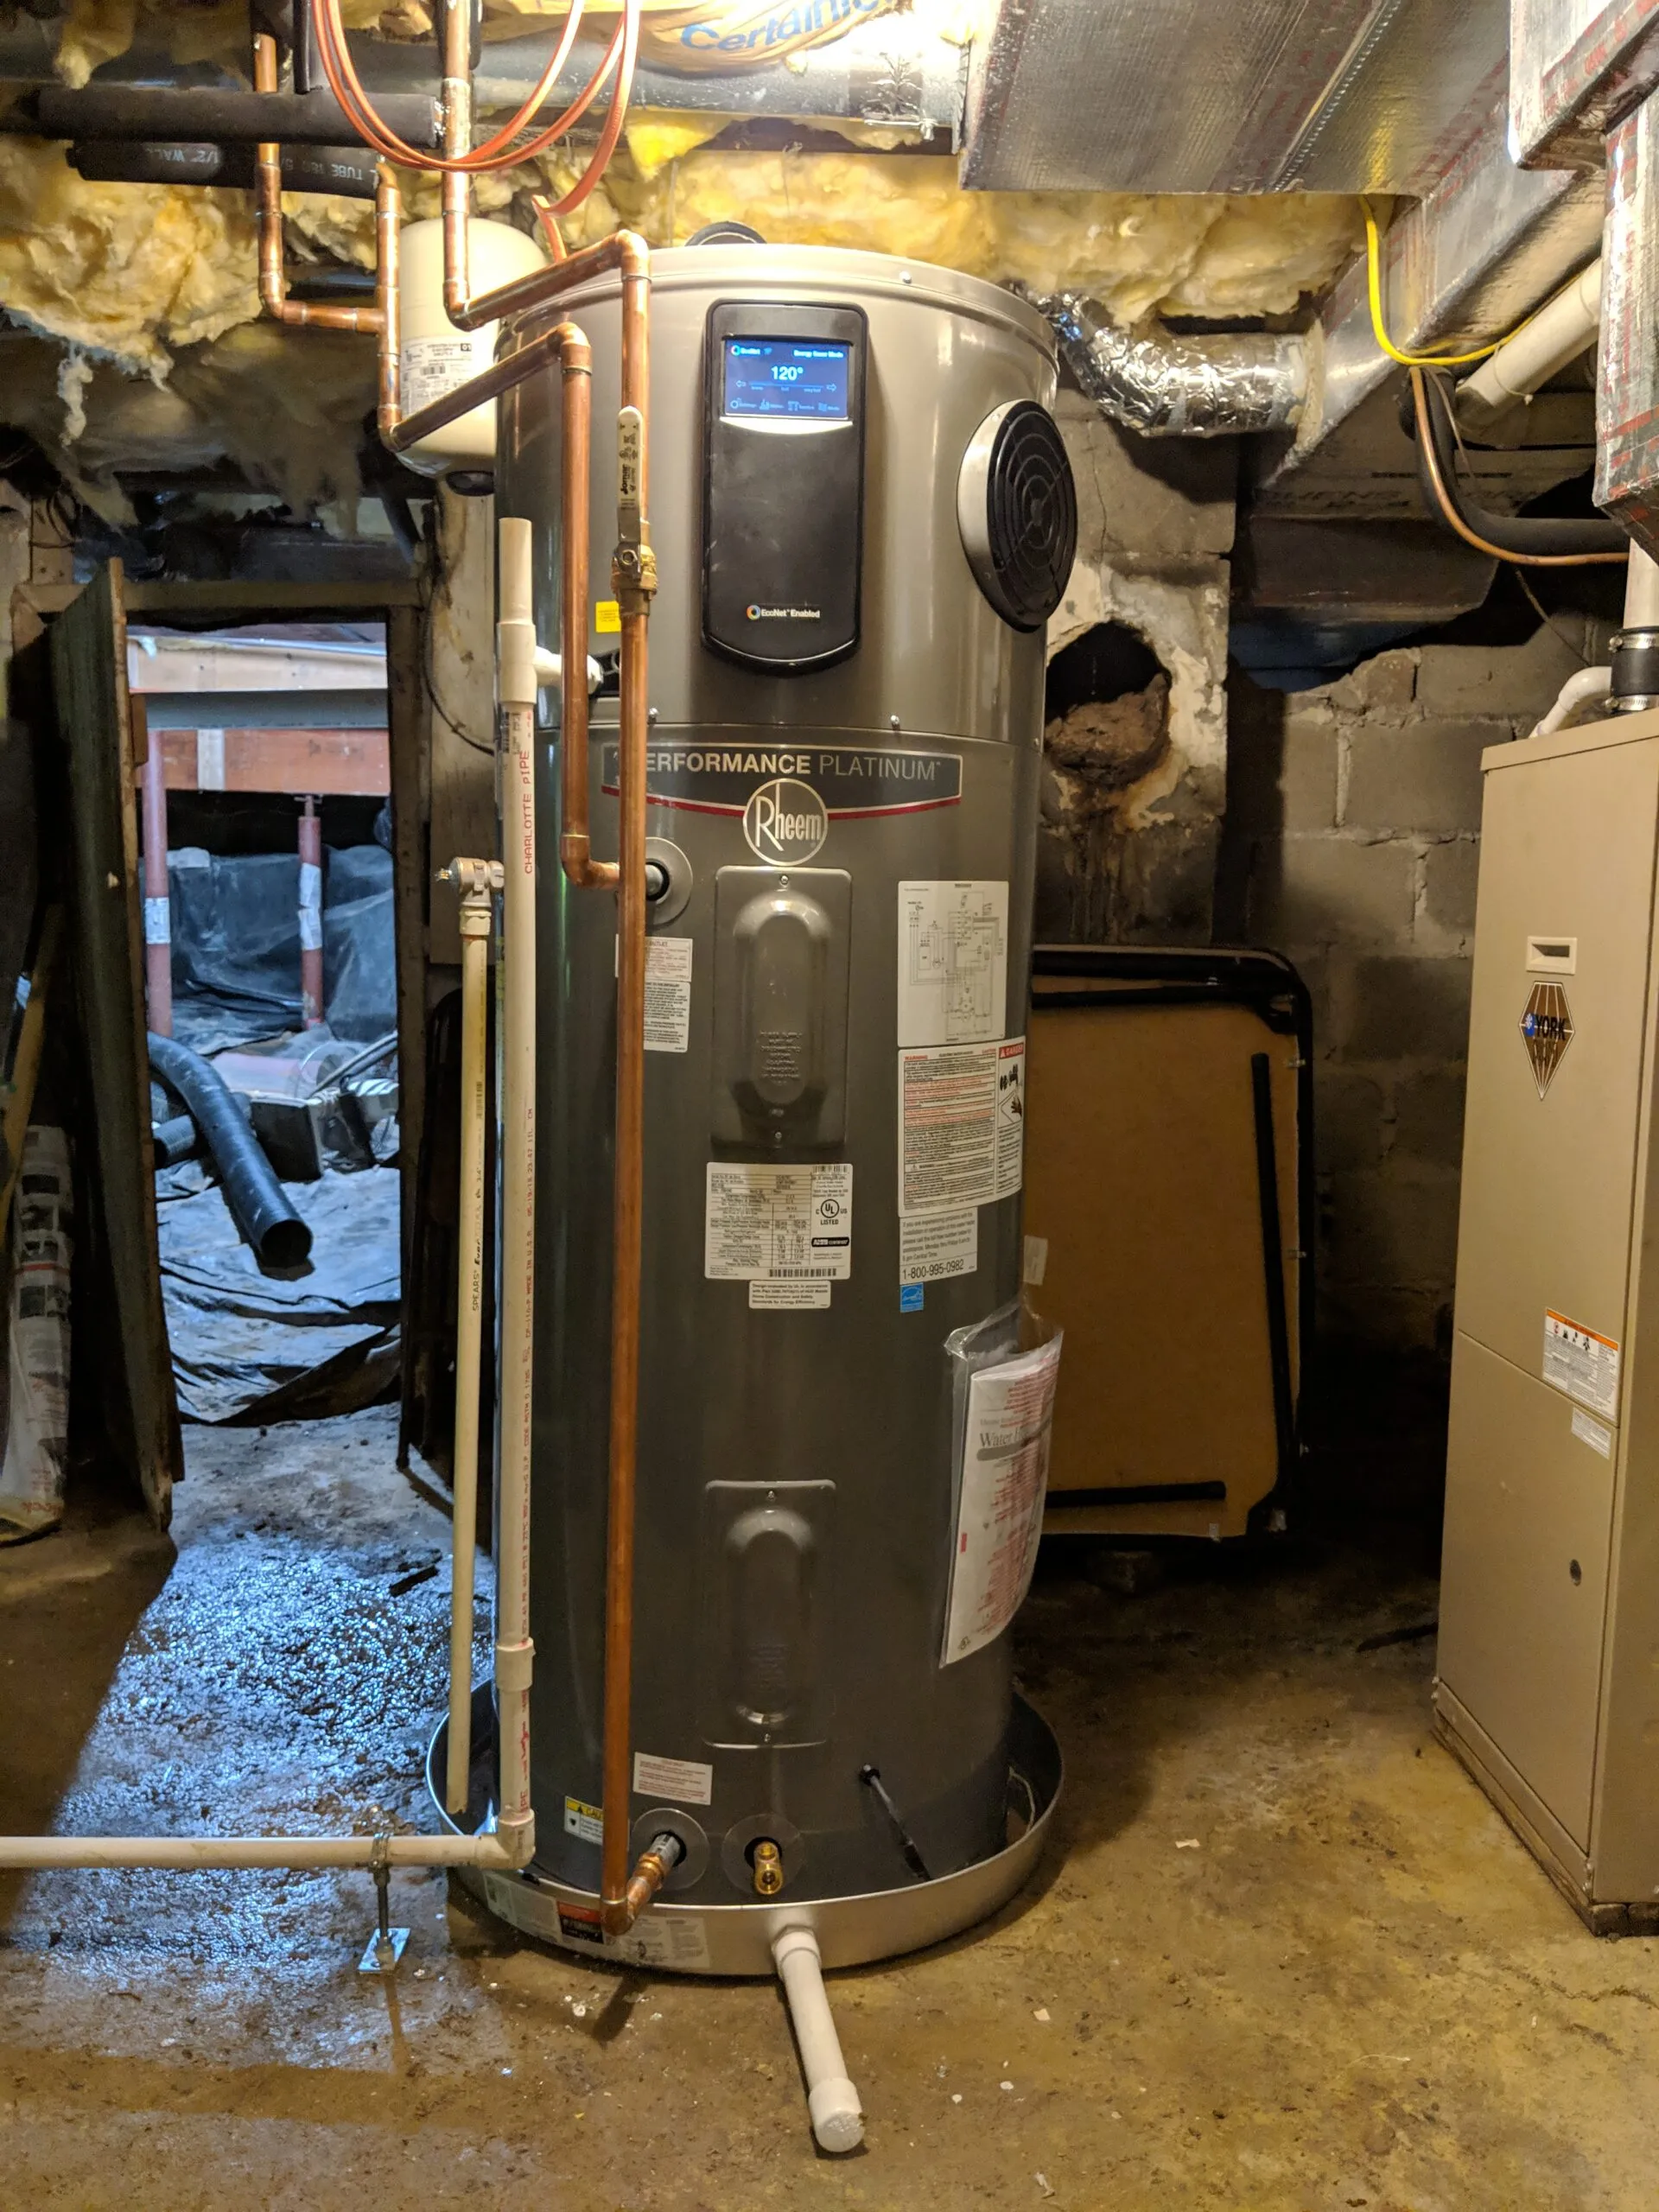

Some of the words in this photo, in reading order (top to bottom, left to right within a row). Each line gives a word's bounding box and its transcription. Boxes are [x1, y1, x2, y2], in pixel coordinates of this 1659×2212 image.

[790, 609, 821, 618] Enabled
[518, 749, 531, 785] PIPE
[646, 752, 812, 775] ERFORMANCE
[819, 753, 938, 781] PLATINUM
[754, 783, 823, 852] Rheem
[522, 793, 533, 874] CHARLOTTE
[1535, 1014, 1567, 1041] YORK
[824, 1203, 836, 1215] UL
[902, 1259, 964, 1280] 1-800-995-0982
